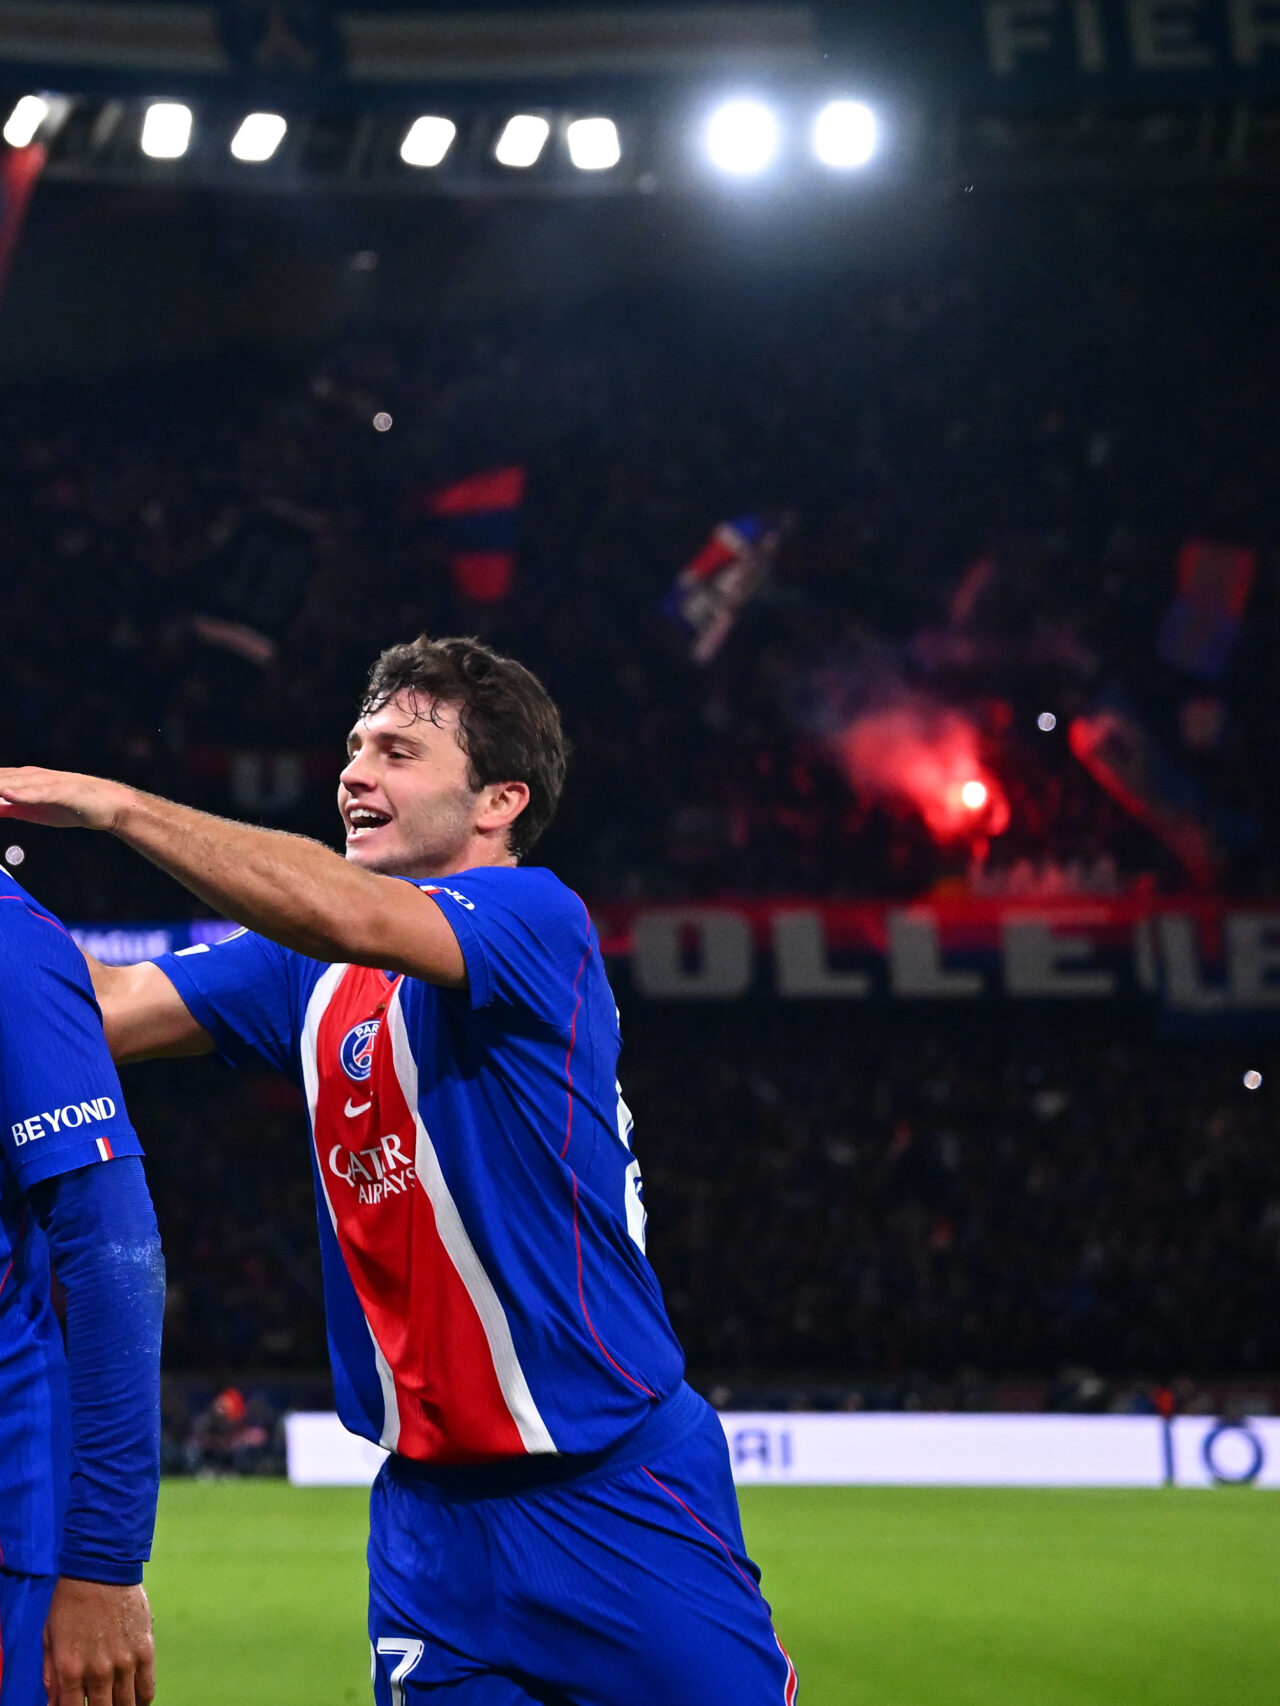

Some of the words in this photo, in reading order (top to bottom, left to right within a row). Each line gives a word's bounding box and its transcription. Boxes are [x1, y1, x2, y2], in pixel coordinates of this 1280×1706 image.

[600, 904, 1160, 998] OLLE
[354, 1023, 380, 1039] PAR
[11, 1096, 116, 1147] BEYOND
[328, 1133, 413, 1188] QATR
[358, 1167, 416, 1205] AIRAYS
[369, 1636, 425, 1706] 7
